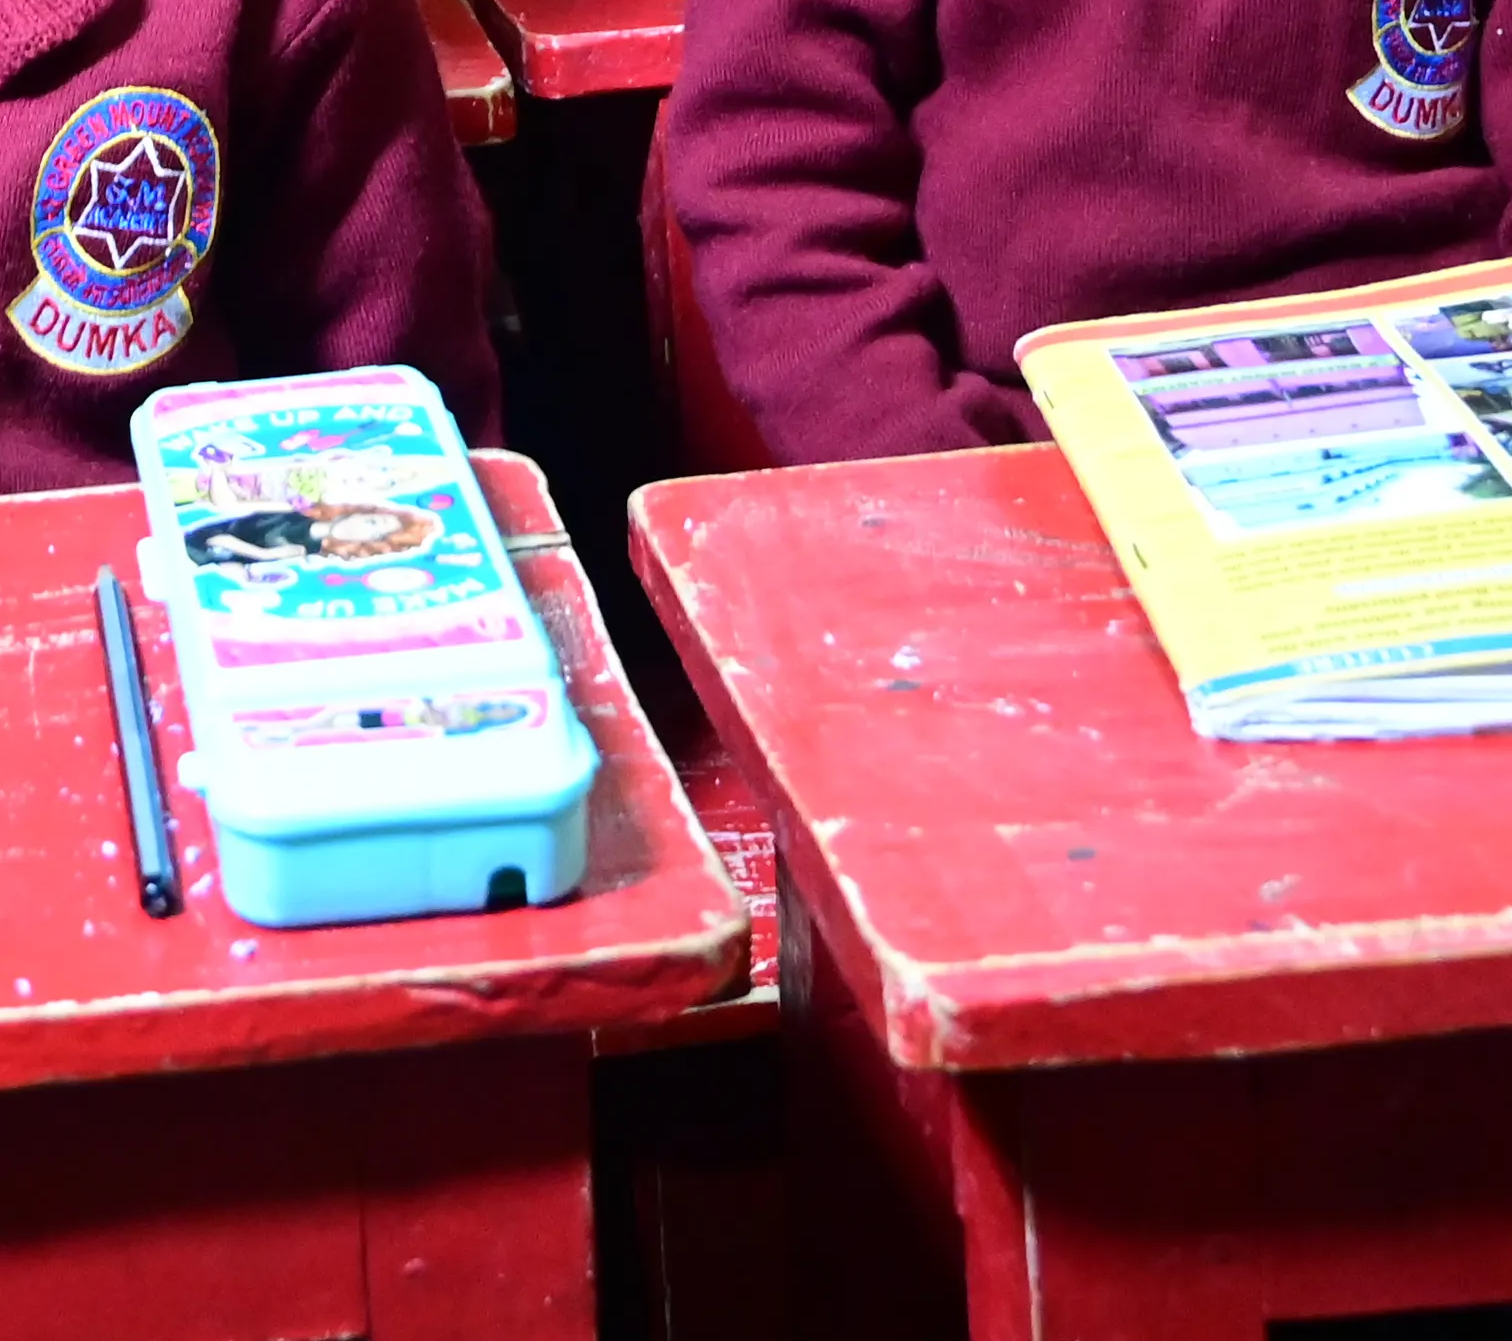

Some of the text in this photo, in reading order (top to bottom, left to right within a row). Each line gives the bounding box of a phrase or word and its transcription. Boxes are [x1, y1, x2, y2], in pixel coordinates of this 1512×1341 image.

[28, 296, 177, 361] DUMKA
[269, 408, 320, 427] UP
[332, 405, 414, 423] AND
